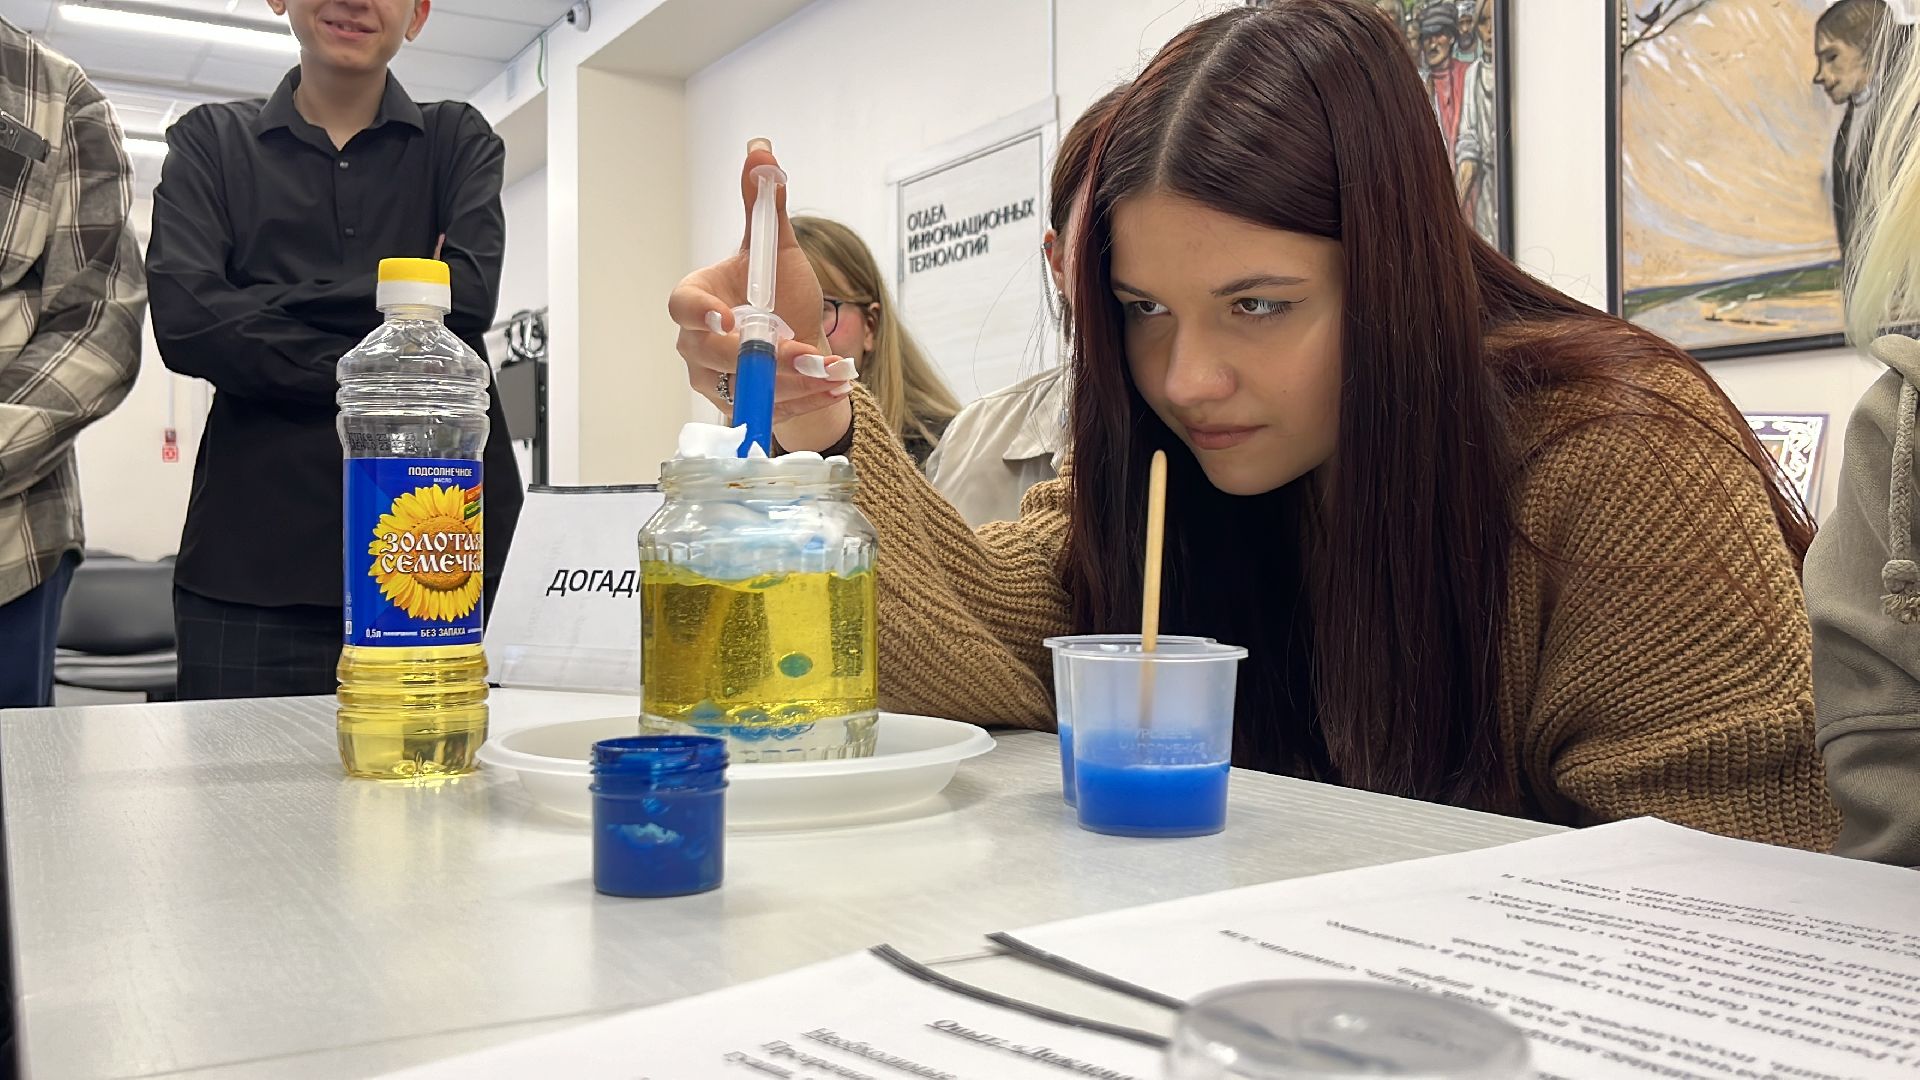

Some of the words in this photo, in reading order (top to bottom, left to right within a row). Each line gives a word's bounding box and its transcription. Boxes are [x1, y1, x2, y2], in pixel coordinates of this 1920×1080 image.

[907, 203, 946, 231] ОТДЕЛ
[907, 198, 1035, 252] ИНФОРМАЦИОННЫХ
[908, 234, 989, 274] ТЕХНОЛОГИЙ
[408, 466, 473, 477] ПОДСОЛНЕЧНОЕ
[420, 628, 437, 638] БЕЗ
[438, 627, 466, 637] ЗАПАХА
